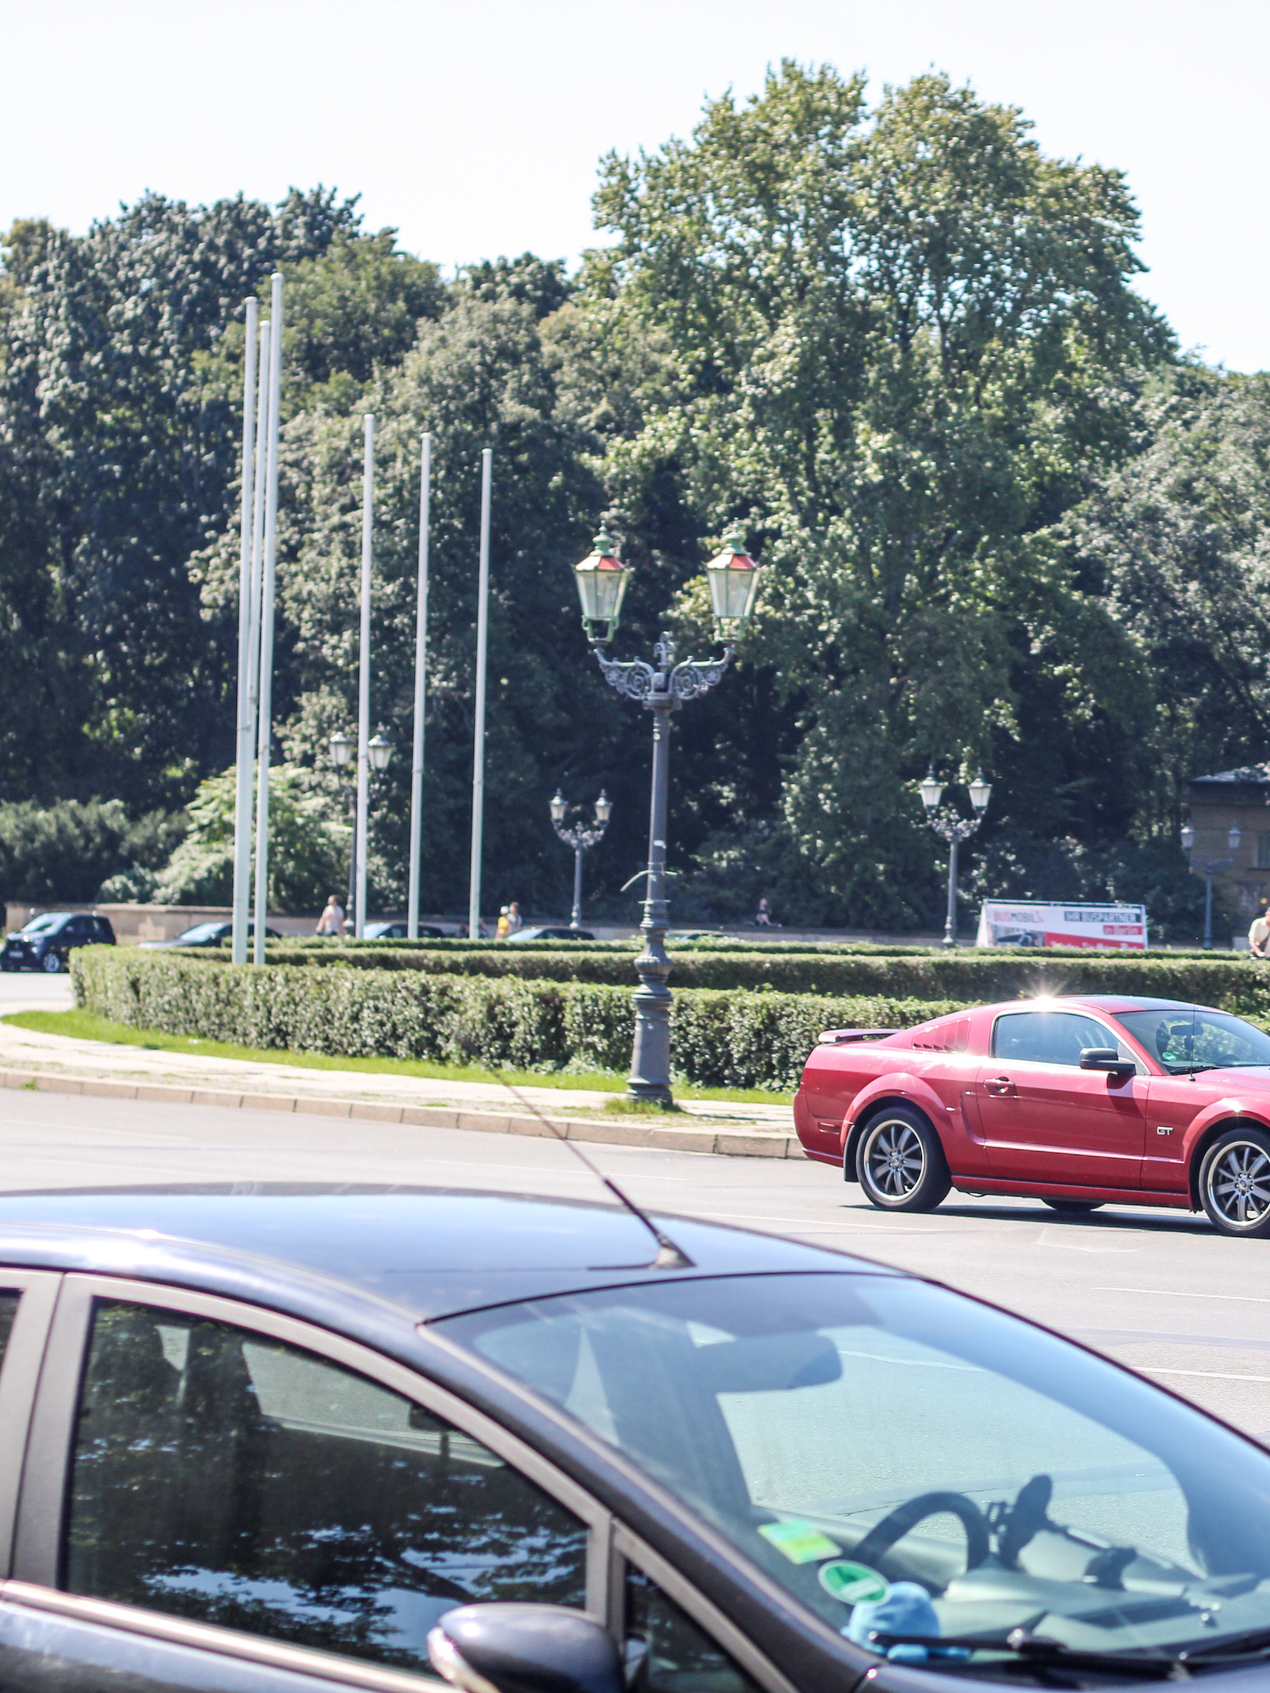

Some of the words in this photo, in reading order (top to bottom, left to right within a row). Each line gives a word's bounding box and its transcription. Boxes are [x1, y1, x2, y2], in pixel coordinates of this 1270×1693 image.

[1065, 911, 1081, 922] IHR
[1081, 911, 1136, 923] BUSPARTNER
[1113, 926, 1139, 935] Berlin
[1156, 1126, 1174, 1136] GT
